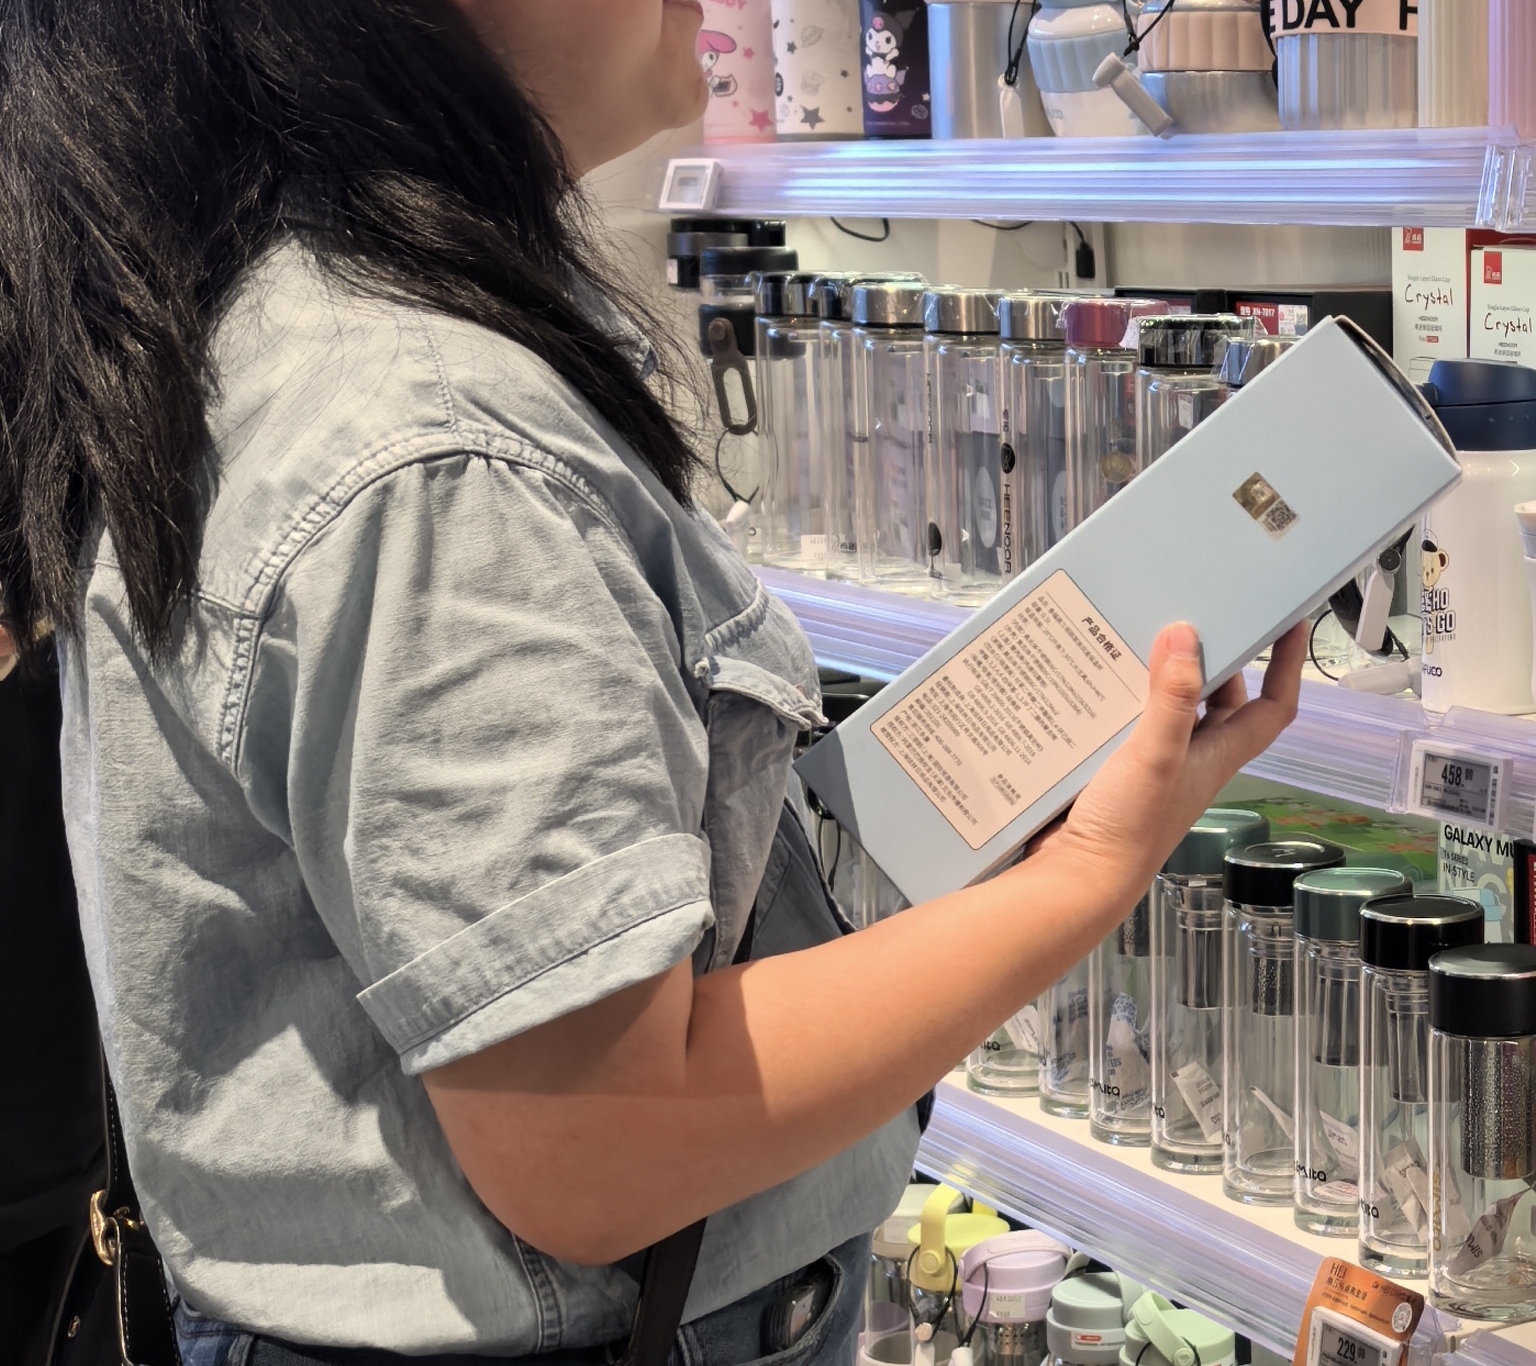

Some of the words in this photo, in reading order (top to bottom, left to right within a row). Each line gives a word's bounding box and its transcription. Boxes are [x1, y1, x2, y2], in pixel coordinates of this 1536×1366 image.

[1404, 283, 1454, 310] Crystal
[1484, 313, 1533, 338] Crystal
[1003, 483, 1013, 574] HEENOOR
[1433, 587, 1449, 611] HO
[1436, 609, 1456, 634] GO
[1080, 613, 1124, 663] 产品合格证
[1440, 762, 1474, 791] 458.00
[1443, 823, 1494, 855] GALAXY
[1329, 1262, 1348, 1279] HEI
[1336, 1335, 1366, 1364] 229.00
